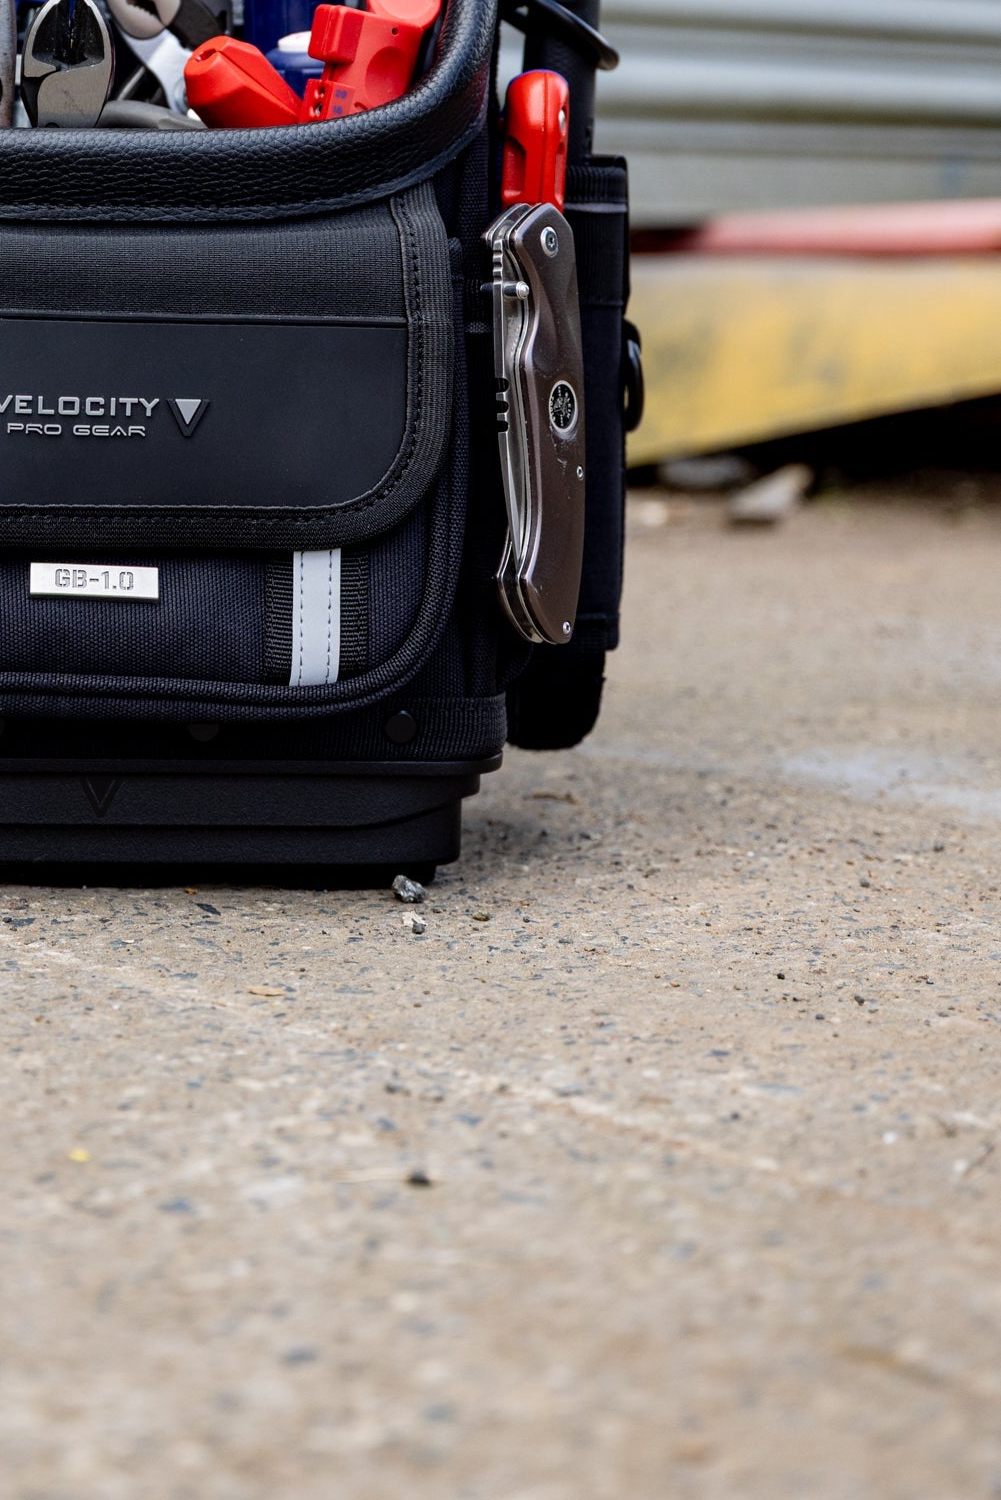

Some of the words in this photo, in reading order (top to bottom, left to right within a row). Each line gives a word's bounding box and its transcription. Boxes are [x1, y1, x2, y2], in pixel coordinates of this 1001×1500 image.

[7, 423, 62, 436] PRO
[73, 424, 146, 437] GEAR
[54, 568, 134, 591] GB-1.0
